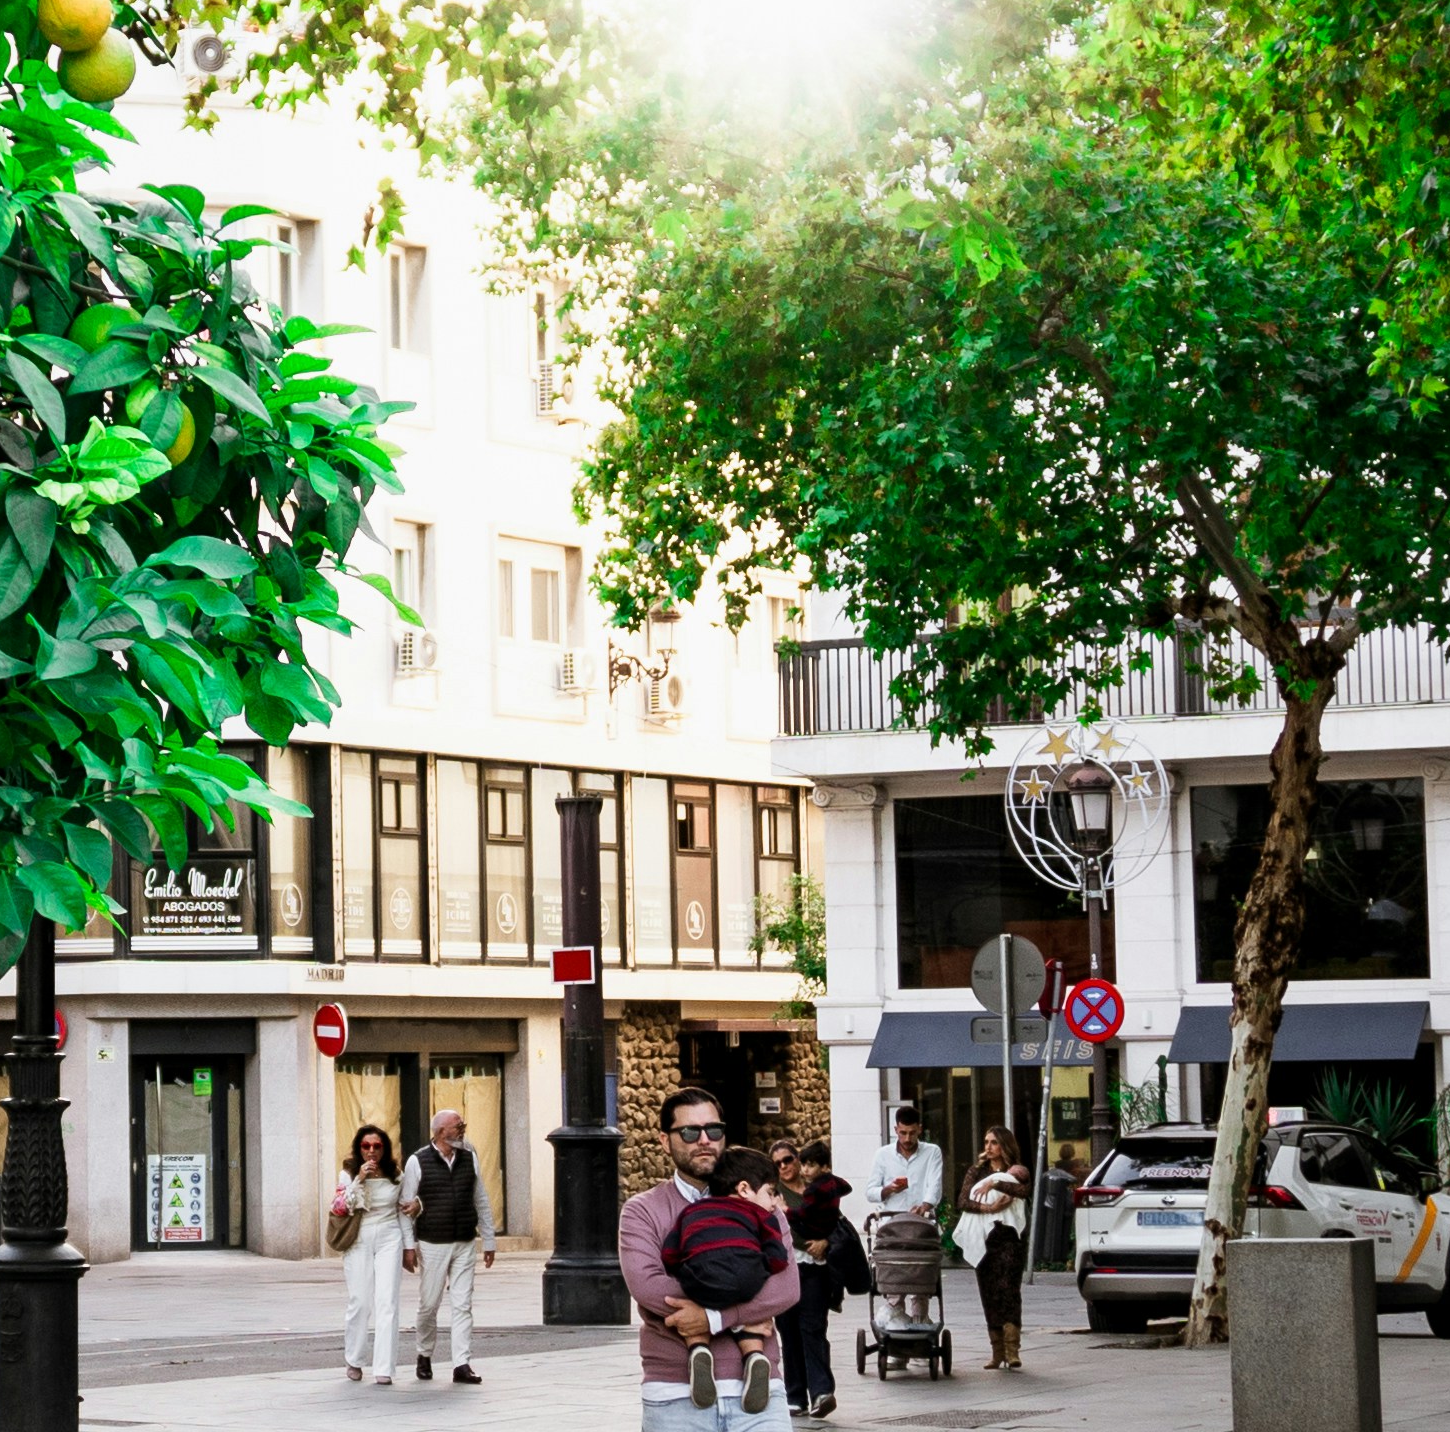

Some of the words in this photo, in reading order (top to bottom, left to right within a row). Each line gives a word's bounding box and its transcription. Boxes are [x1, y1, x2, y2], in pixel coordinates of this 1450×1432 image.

[144, 868, 182, 898] Emilio
[188, 867, 243, 900] Moeckel
[162, 901, 225, 912] ABOGADOS
[306, 968, 345, 980] MADRID
